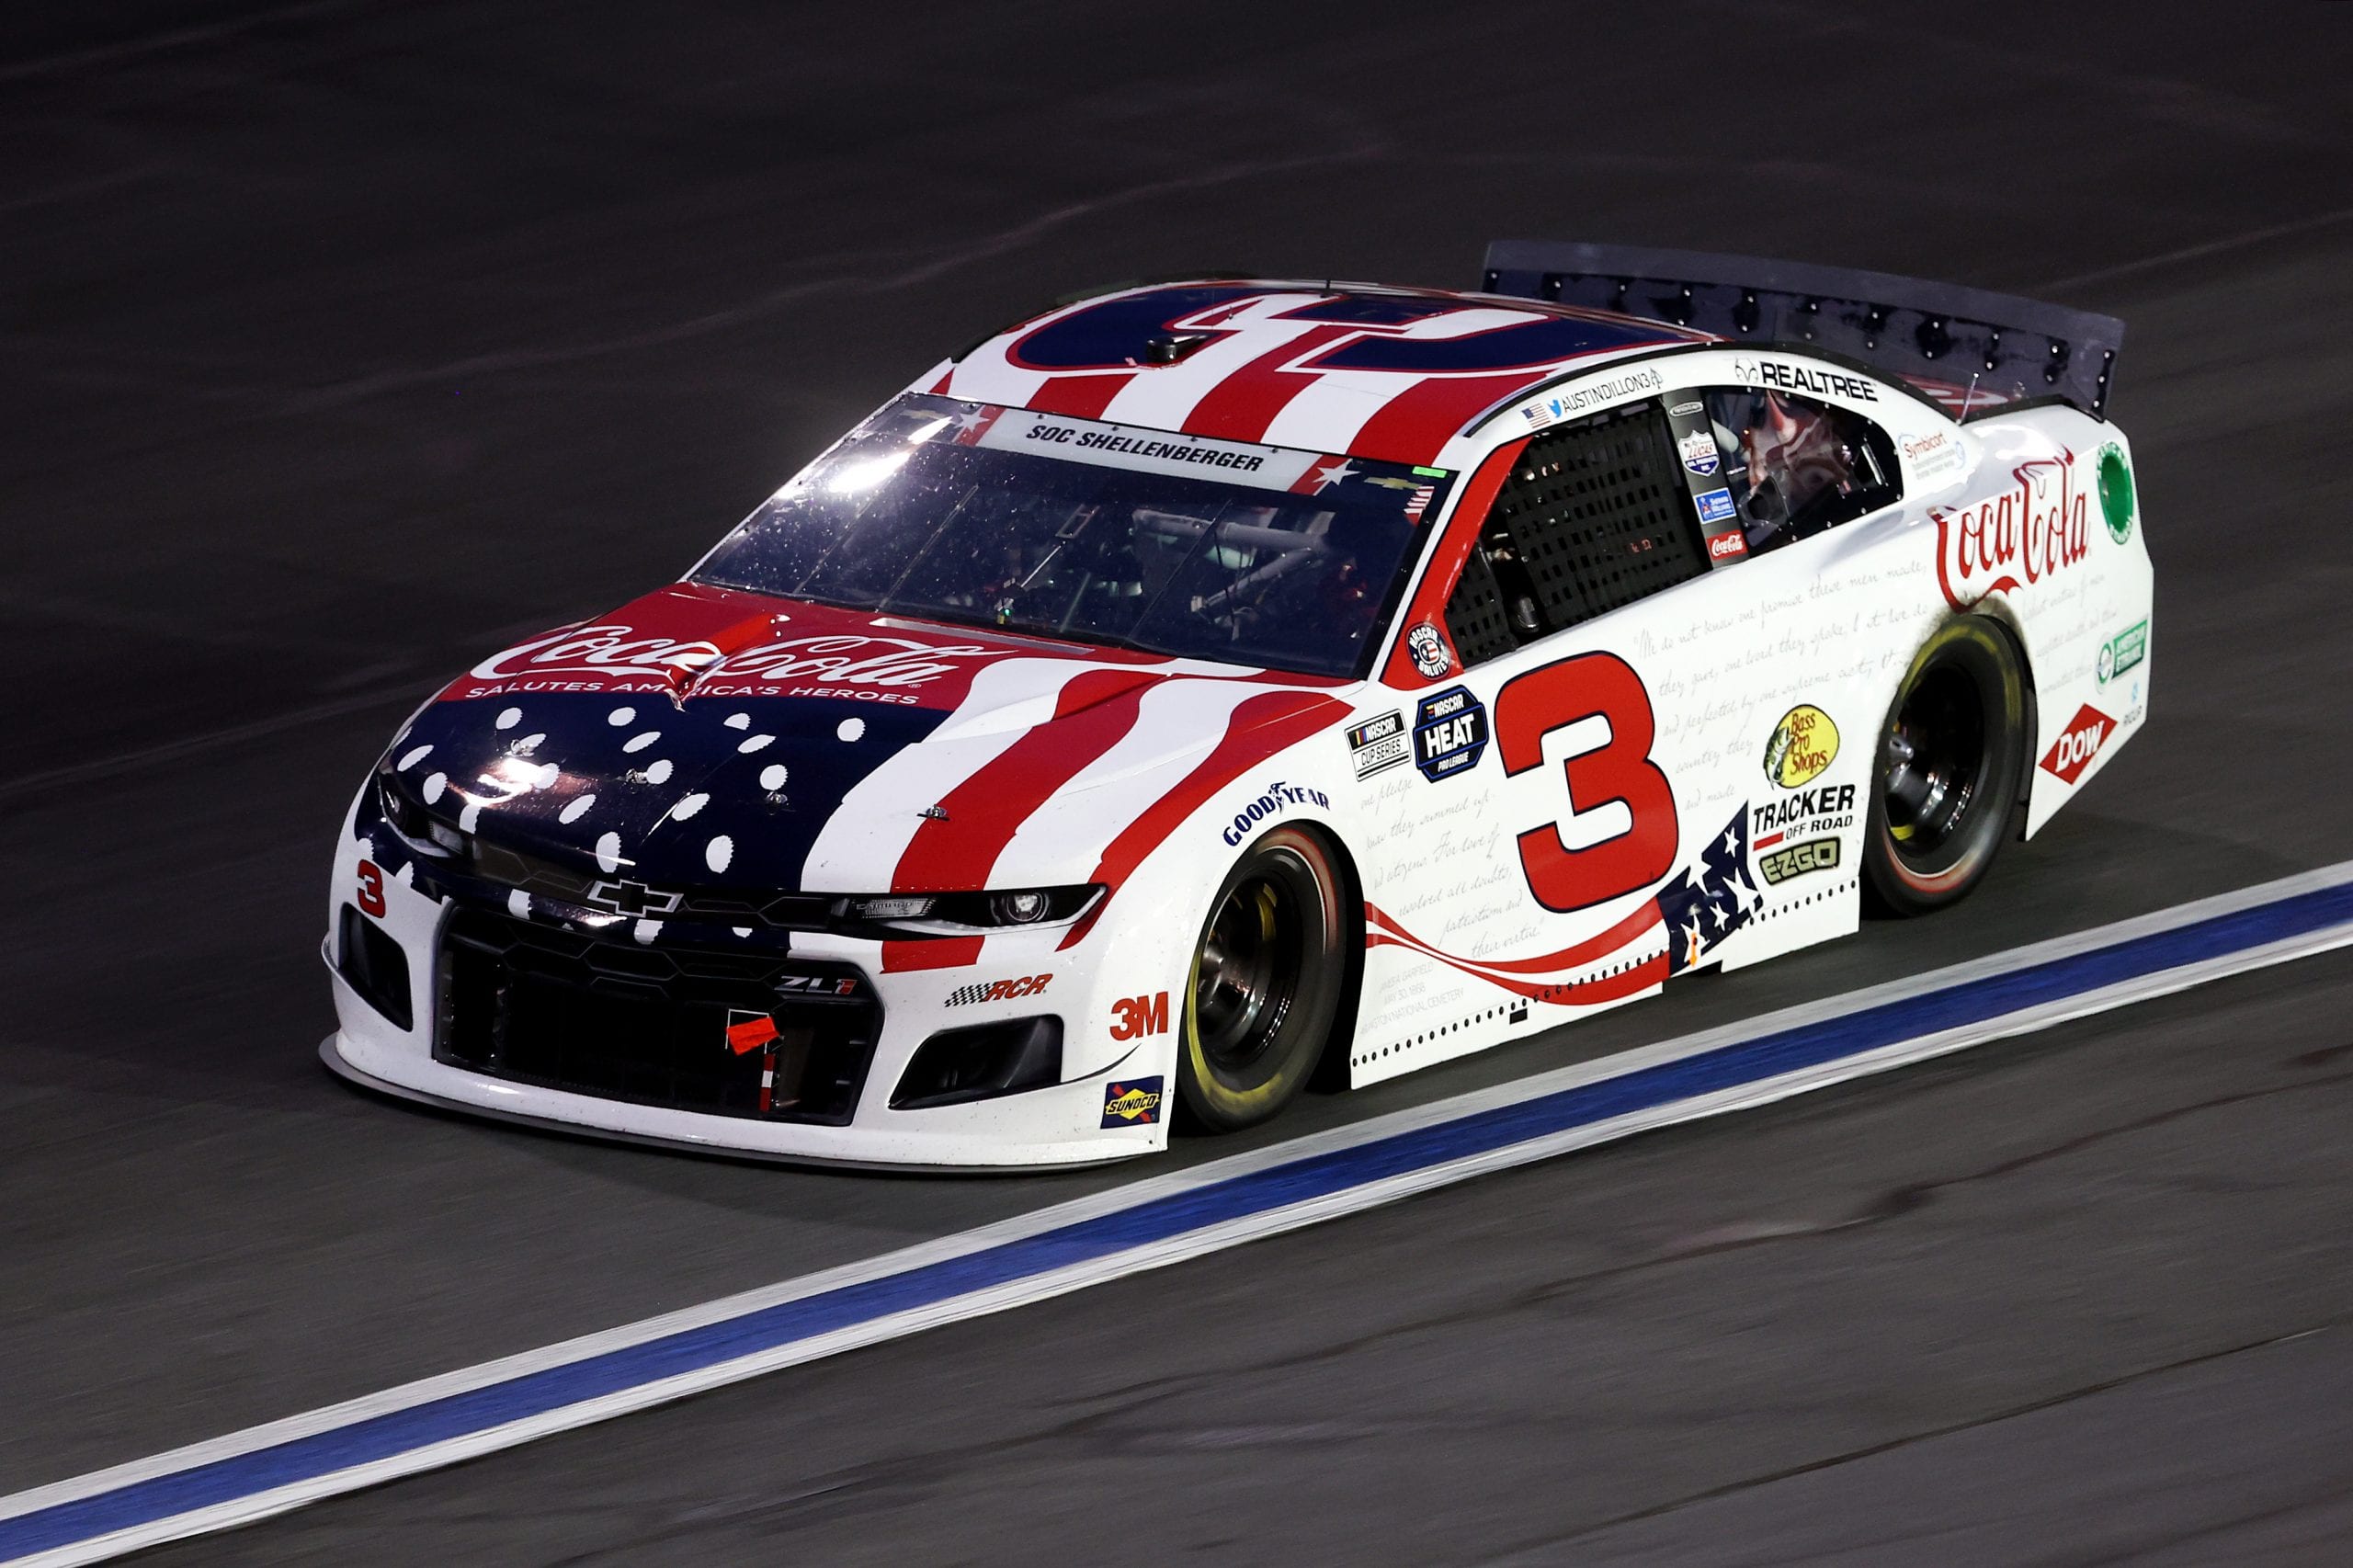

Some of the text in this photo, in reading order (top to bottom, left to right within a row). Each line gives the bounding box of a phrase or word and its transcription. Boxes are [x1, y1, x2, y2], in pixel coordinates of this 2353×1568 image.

[1561, 373, 1651, 415] AUSTINDILLON3
[1759, 361, 1879, 402] REALTREE
[1027, 424, 1264, 472] SOC SHELLENBERGER
[1688, 443, 1713, 459] LUCAS
[1904, 431, 1948, 461] Symbicort
[1409, 626, 1439, 650] NASCAR
[465, 680, 920, 705] SALUTES AMICA'S HEROES
[1434, 693, 1464, 719] NASCAR
[1365, 716, 1397, 743] NASCAR
[1425, 713, 1474, 759] HEAT
[1791, 712, 1816, 735] Bass
[1360, 738, 1402, 767] CUP SERIES
[1790, 733, 1810, 755] Pro
[2055, 720, 2106, 773] DOW
[1438, 751, 1470, 773] PRO LEAGUE
[1790, 749, 1828, 776] Shops
[1495, 650, 1678, 913] 3
[1222, 781, 1330, 846] GOODYEAR
[1753, 783, 1856, 835] TRACKER
[1786, 814, 1853, 840] OFF ROAD
[358, 858, 386, 919] 3
[774, 975, 858, 994] ZL1
[979, 973, 1053, 1003] RCR
[1109, 991, 1168, 1040] 3M
[1108, 1094, 1158, 1113] SUNOCO
